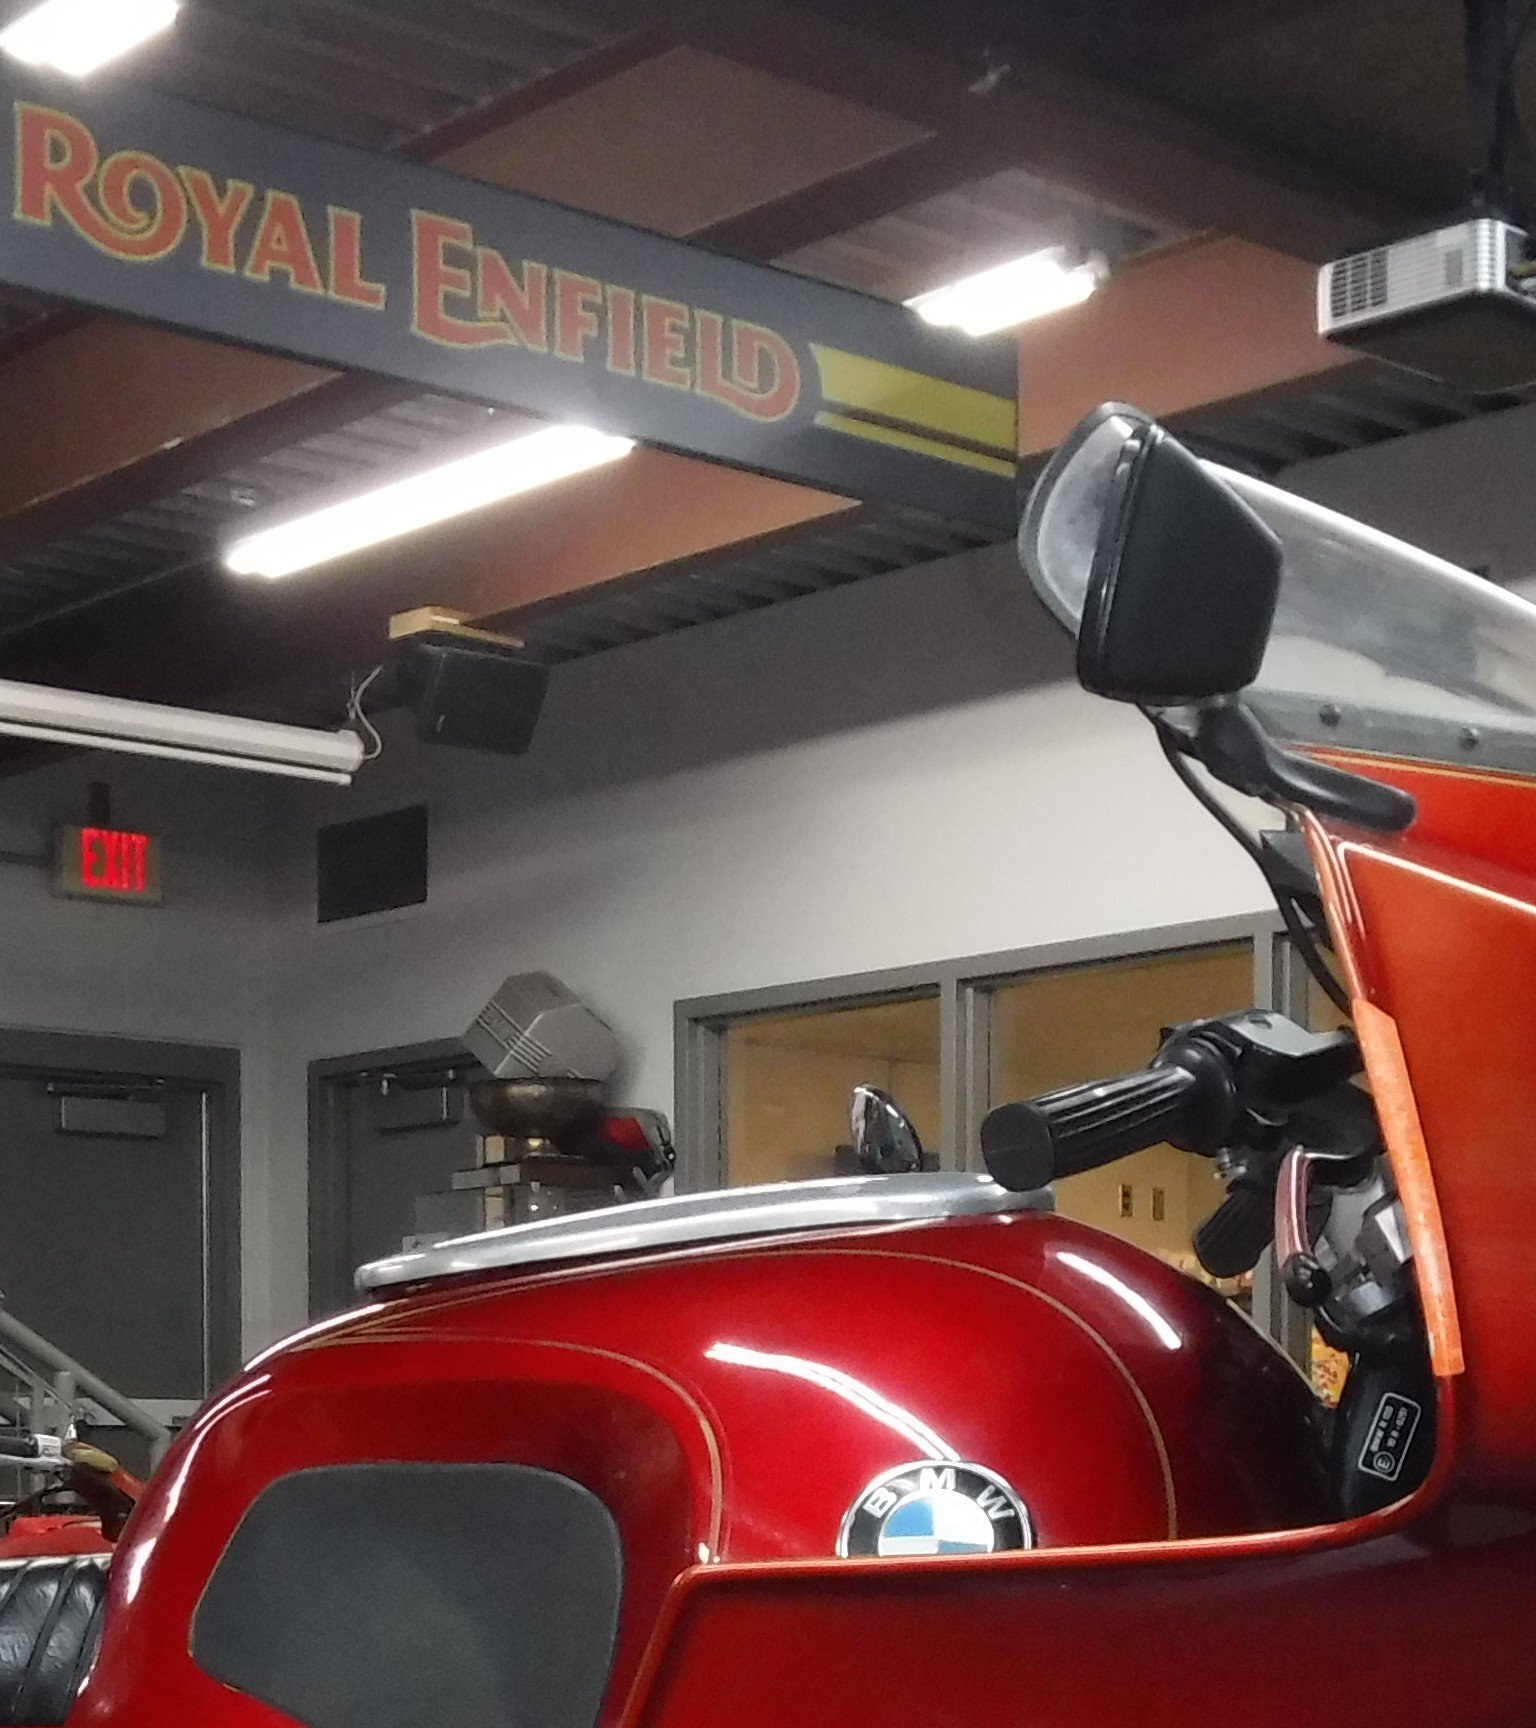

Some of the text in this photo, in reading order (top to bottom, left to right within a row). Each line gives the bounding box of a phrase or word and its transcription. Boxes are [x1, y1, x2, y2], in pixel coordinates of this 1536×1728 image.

[12, 100, 801, 423] ROYAL ENFIELD
[80, 826, 150, 893] EXIT
[862, 1467, 1016, 1521] BMW
